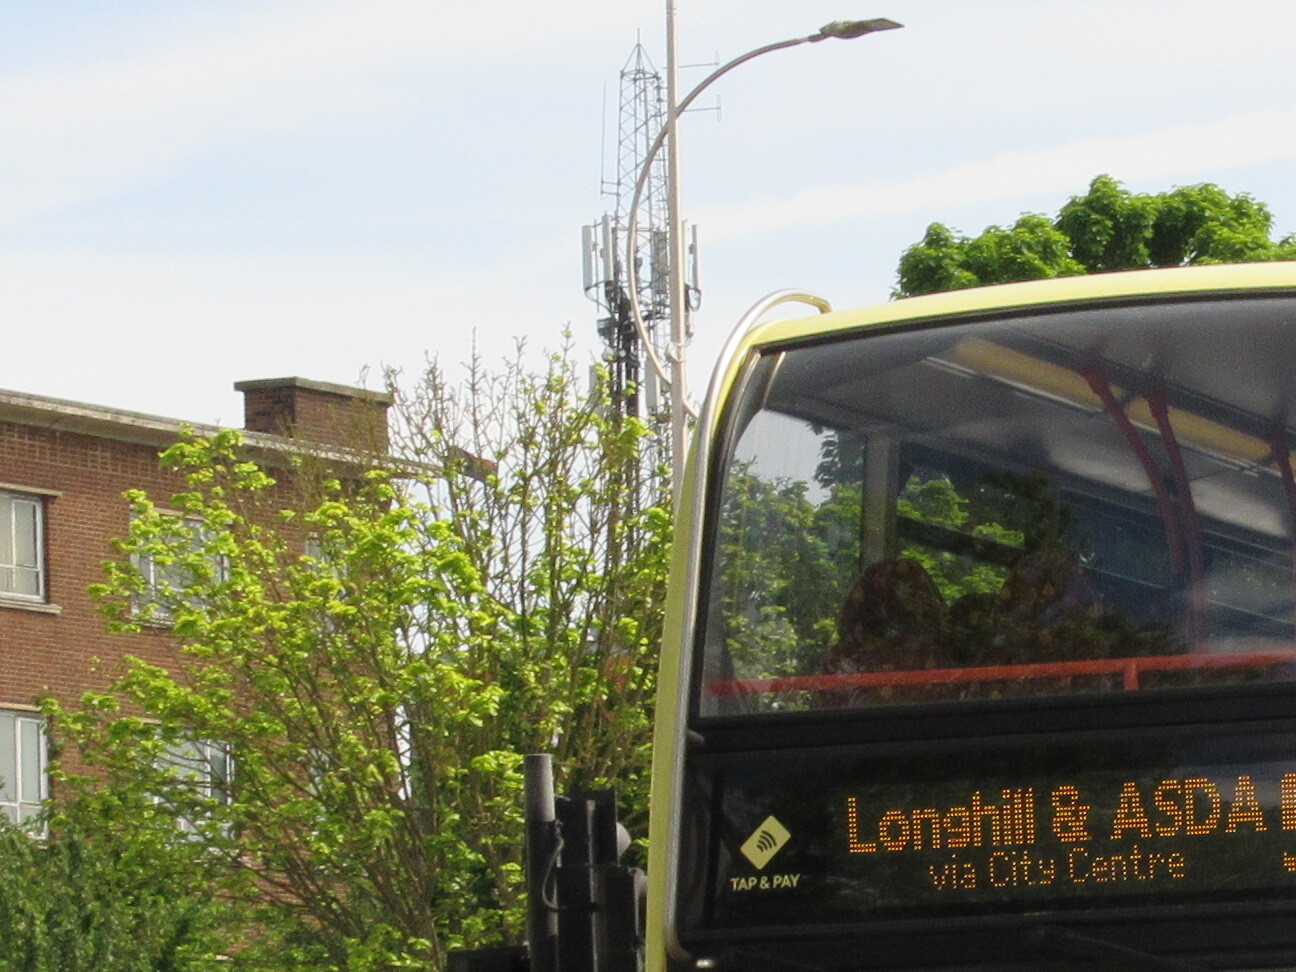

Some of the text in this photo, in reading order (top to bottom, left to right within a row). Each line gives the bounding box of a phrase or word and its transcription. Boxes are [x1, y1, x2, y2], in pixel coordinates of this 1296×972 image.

[848, 774, 1267, 853] Longhill & ASDA
[730, 873, 801, 892] TAP & PAY
[928, 844, 1185, 890] via City Centre
